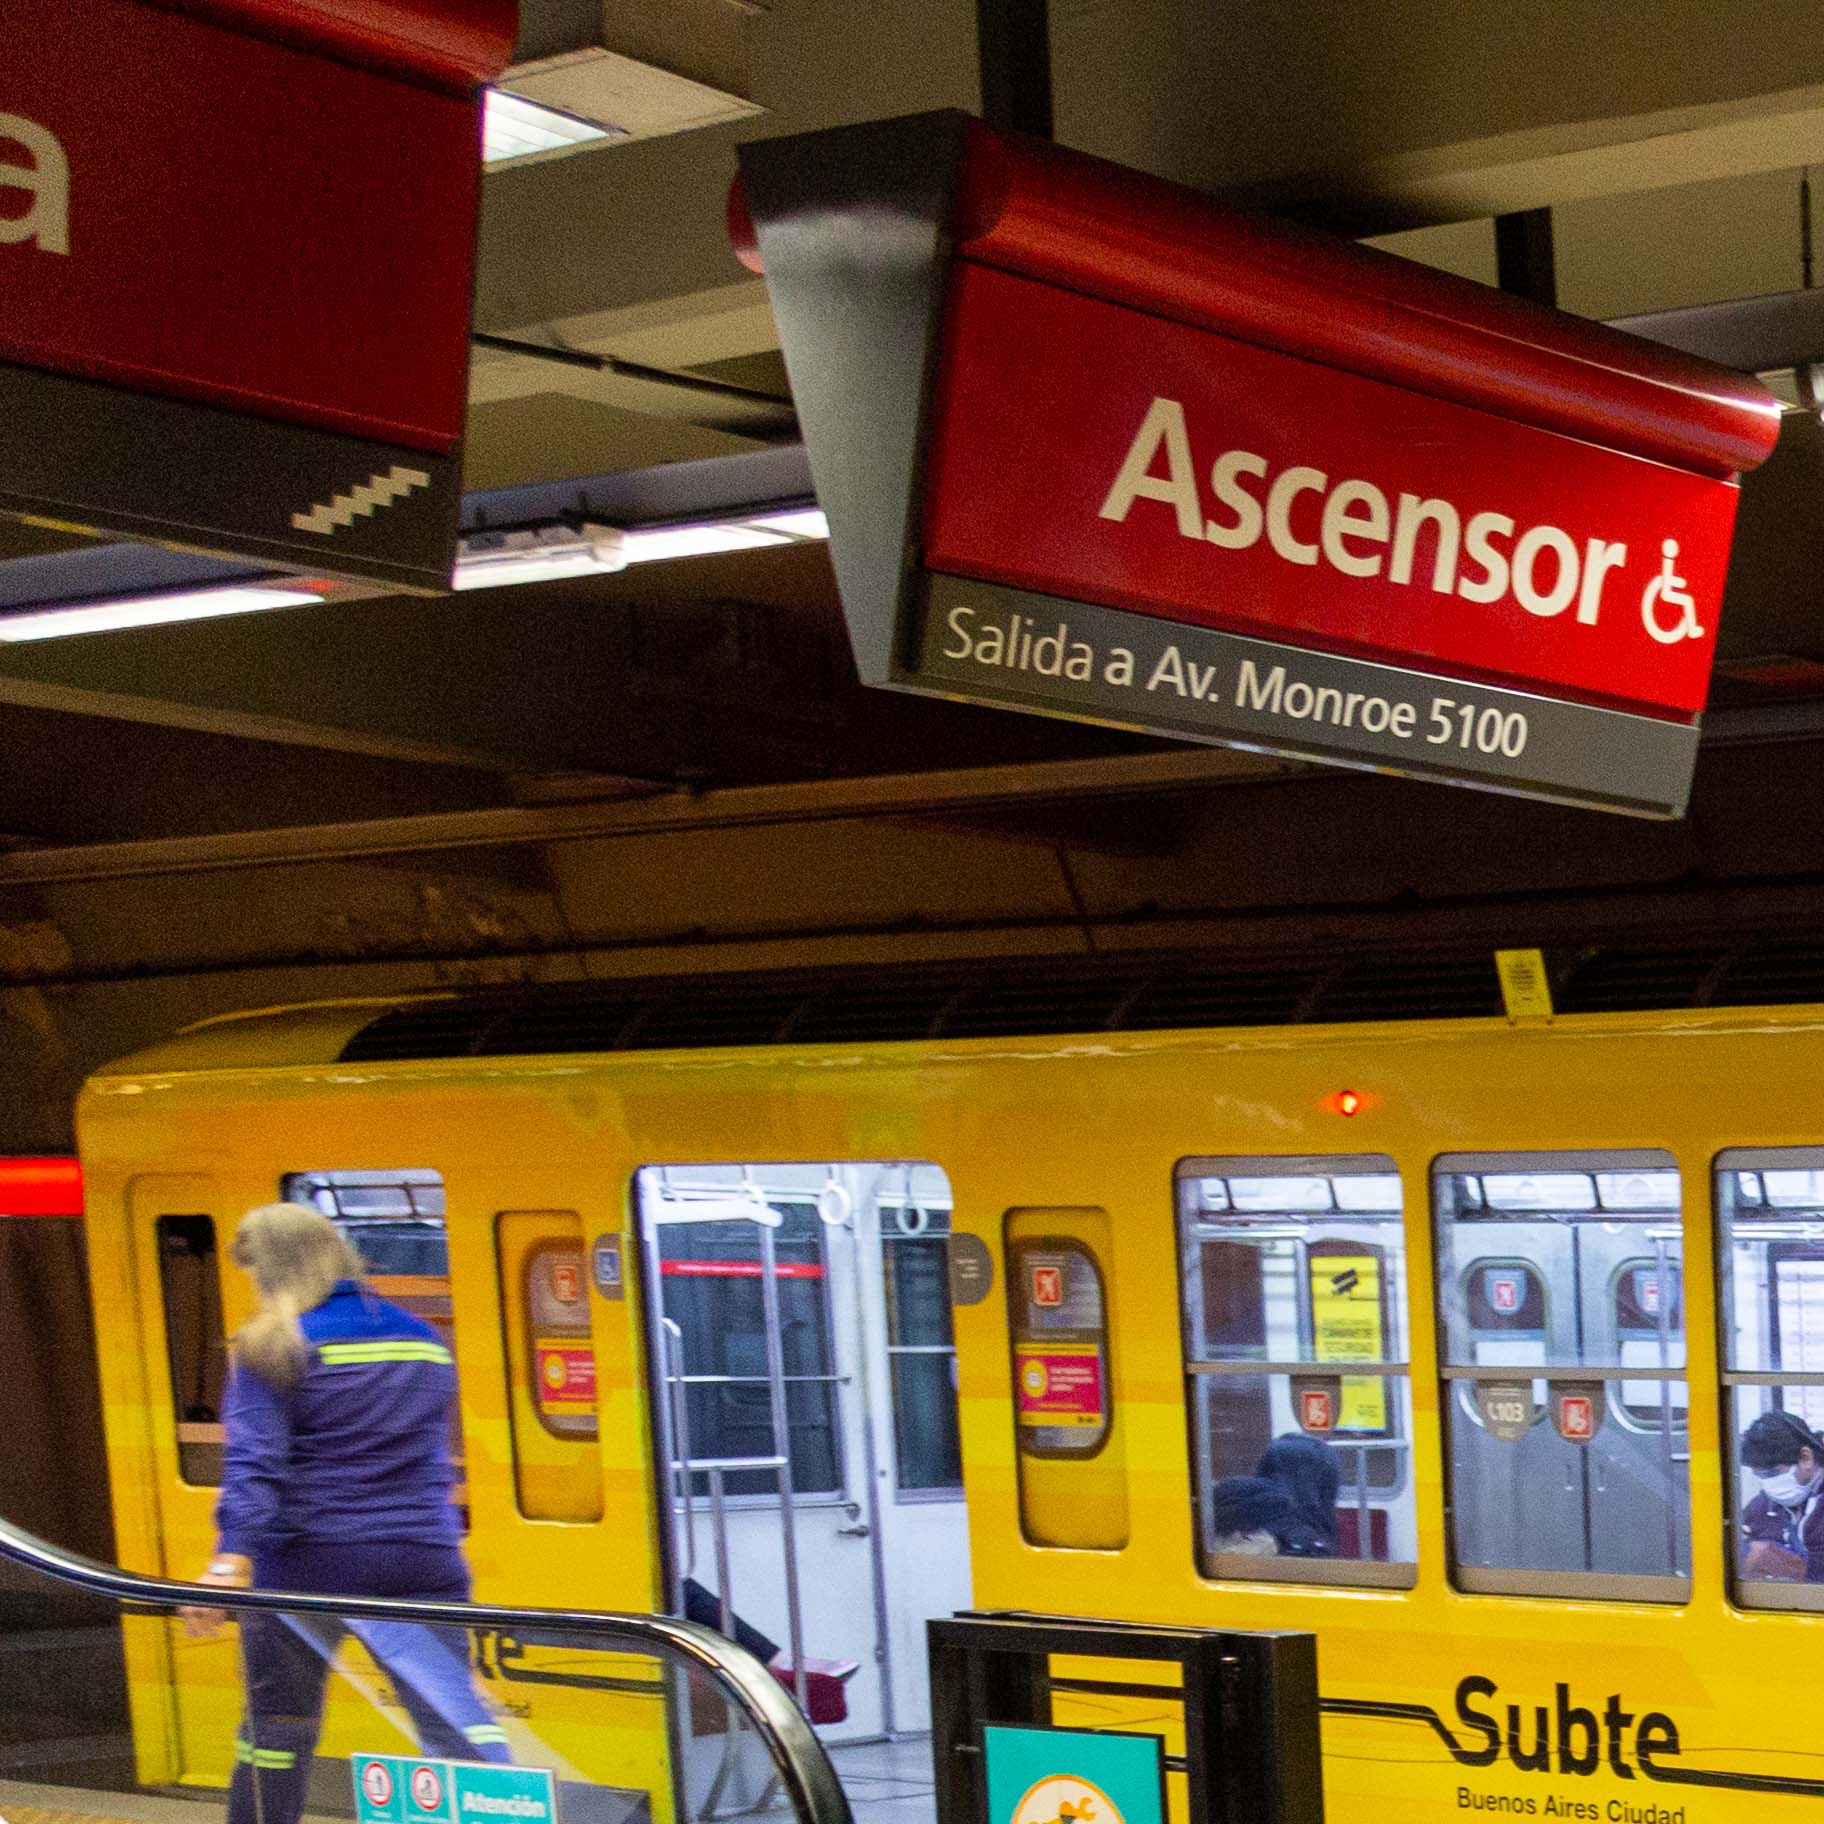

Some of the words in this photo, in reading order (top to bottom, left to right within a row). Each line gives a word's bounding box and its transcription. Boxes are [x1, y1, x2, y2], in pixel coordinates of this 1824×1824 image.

[1099, 396, 1628, 627] Ascensor
[943, 607, 1094, 682] Salida
[1103, 646, 1135, 687] a
[1146, 644, 1220, 704] Av.
[1236, 659, 1417, 739] Monroe
[1427, 697, 1529, 758] 5100
[1452, 1675, 1681, 1782] Subte
[462, 1791, 546, 1818] Atención
[1457, 1786, 1537, 1815] Buenos
[1543, 1795, 1600, 1821] Aires
